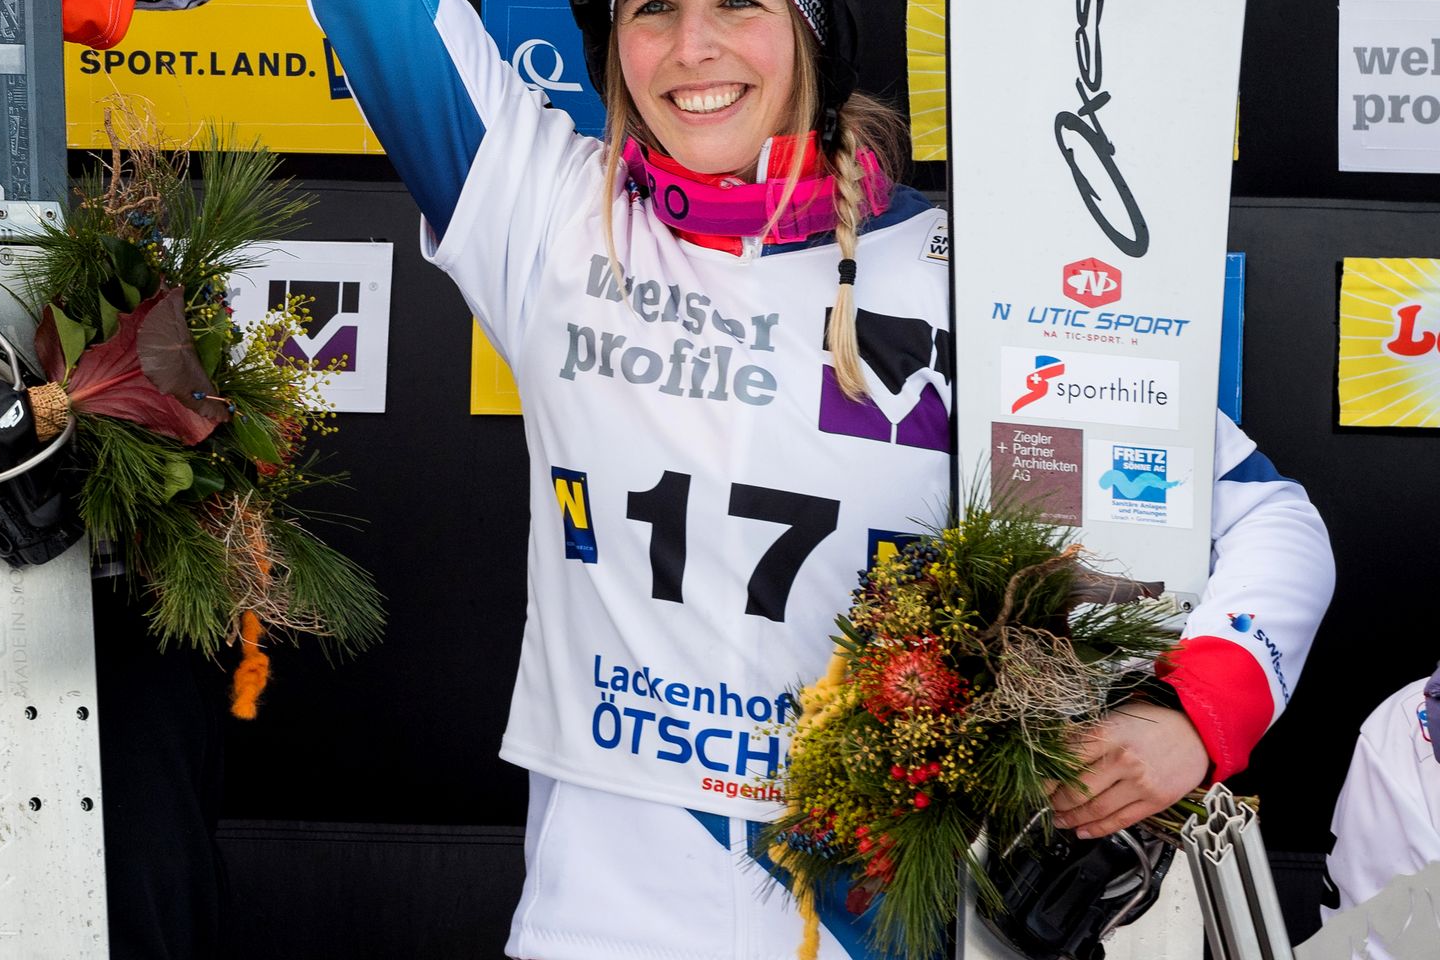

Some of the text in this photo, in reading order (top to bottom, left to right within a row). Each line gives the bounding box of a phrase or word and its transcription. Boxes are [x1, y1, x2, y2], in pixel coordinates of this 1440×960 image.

[79, 49, 316, 78] SPORT.LAND.
[1094, 312, 1192, 337] SPORT
[559, 322, 779, 406] profile
[1056, 377, 1169, 406] sporthilfe
[1013, 430, 1053, 445] Ziegler
[1013, 443, 1055, 457] Partner
[1012, 456, 1078, 473] Architekten
[1114, 446, 1166, 464] FRETZ
[1012, 469, 1031, 482] AG
[1153, 464, 1166, 473] AG
[625, 469, 841, 624] 17
[593, 655, 792, 724] Lackenhof
[591, 692, 782, 777] ÖTSCH
